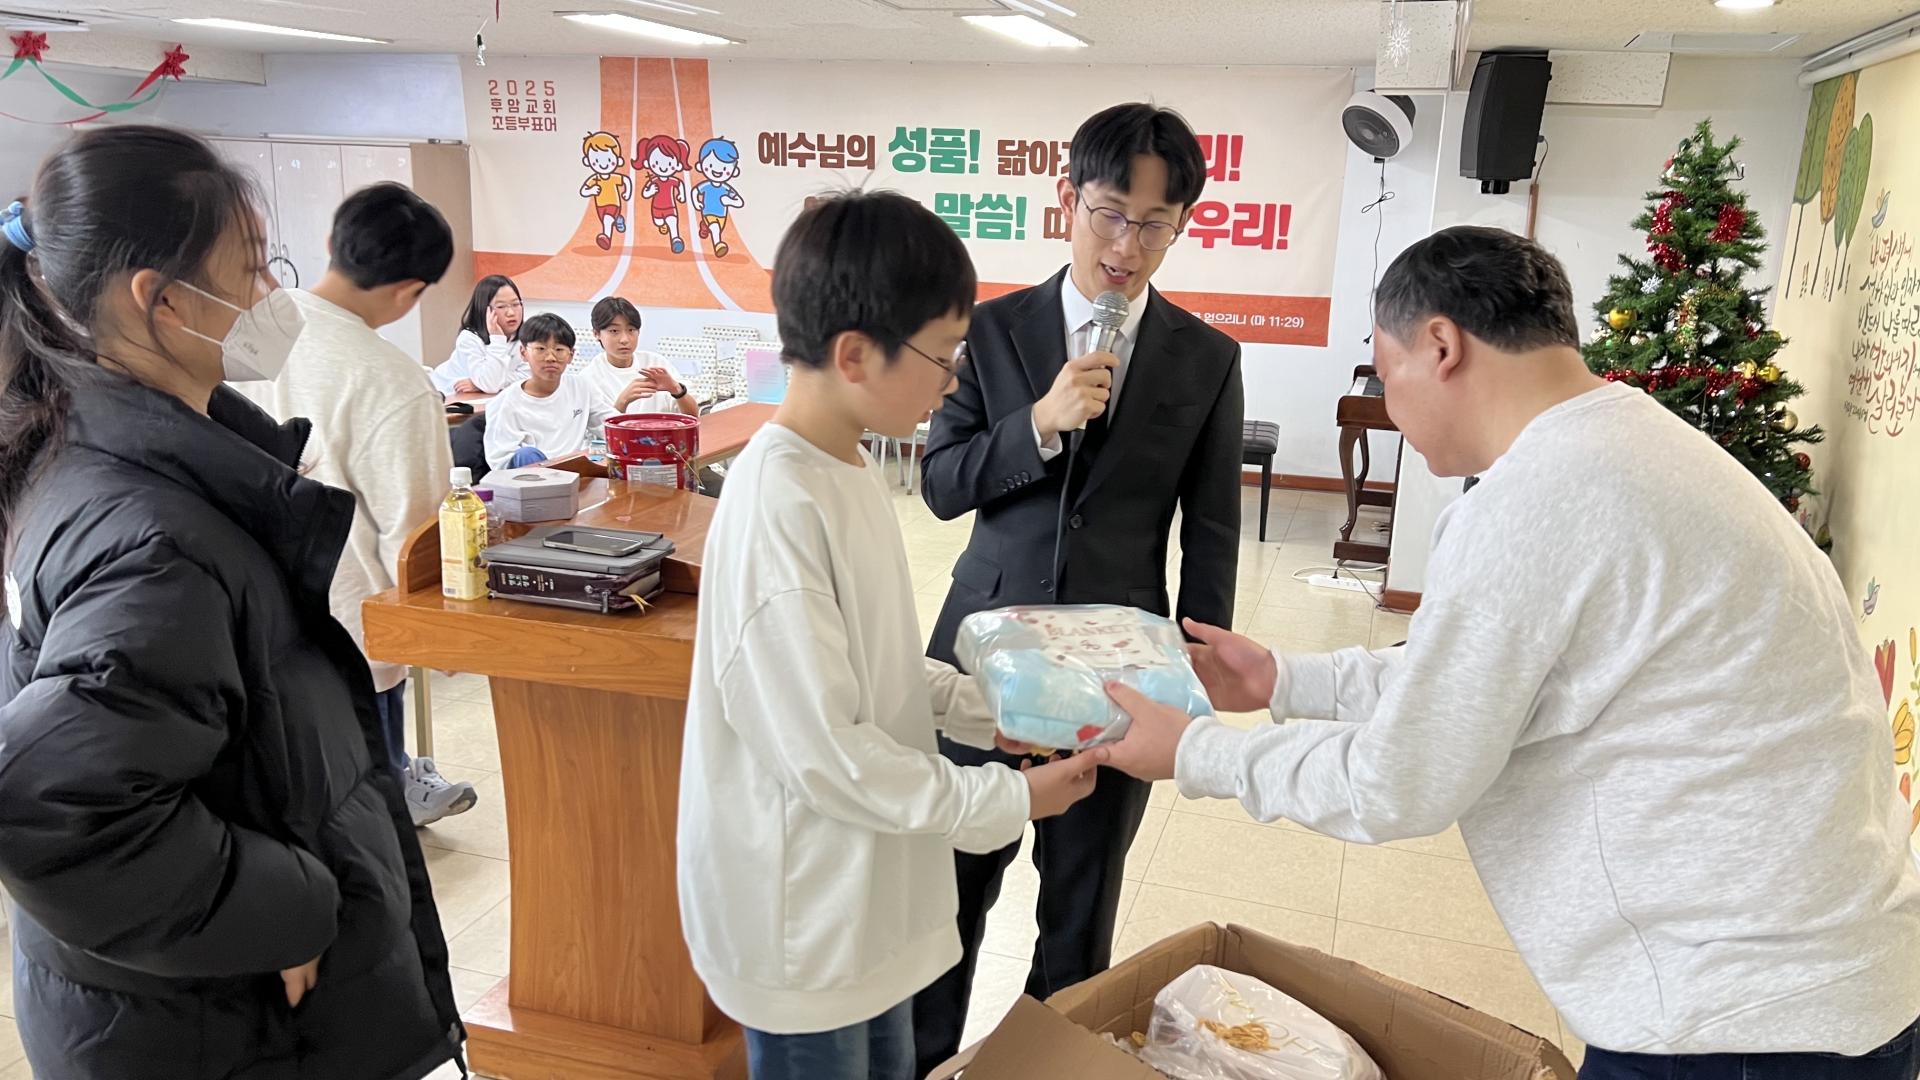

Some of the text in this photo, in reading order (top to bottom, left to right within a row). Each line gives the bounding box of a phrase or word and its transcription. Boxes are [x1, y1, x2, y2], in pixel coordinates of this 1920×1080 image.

[487, 79, 555, 97] 2025
[490, 98, 556, 114] 후암교회
[492, 115, 557, 132] 초등부표어
[757, 131, 876, 171] 예수님의
[888, 126, 981, 174] 성품!
[934, 192, 1028, 241] 말씀!
[1188, 200, 1292, 250] 우리!
[1250, 315, 1265, 327] (마
[1269, 315, 1305, 329] 11:29)
